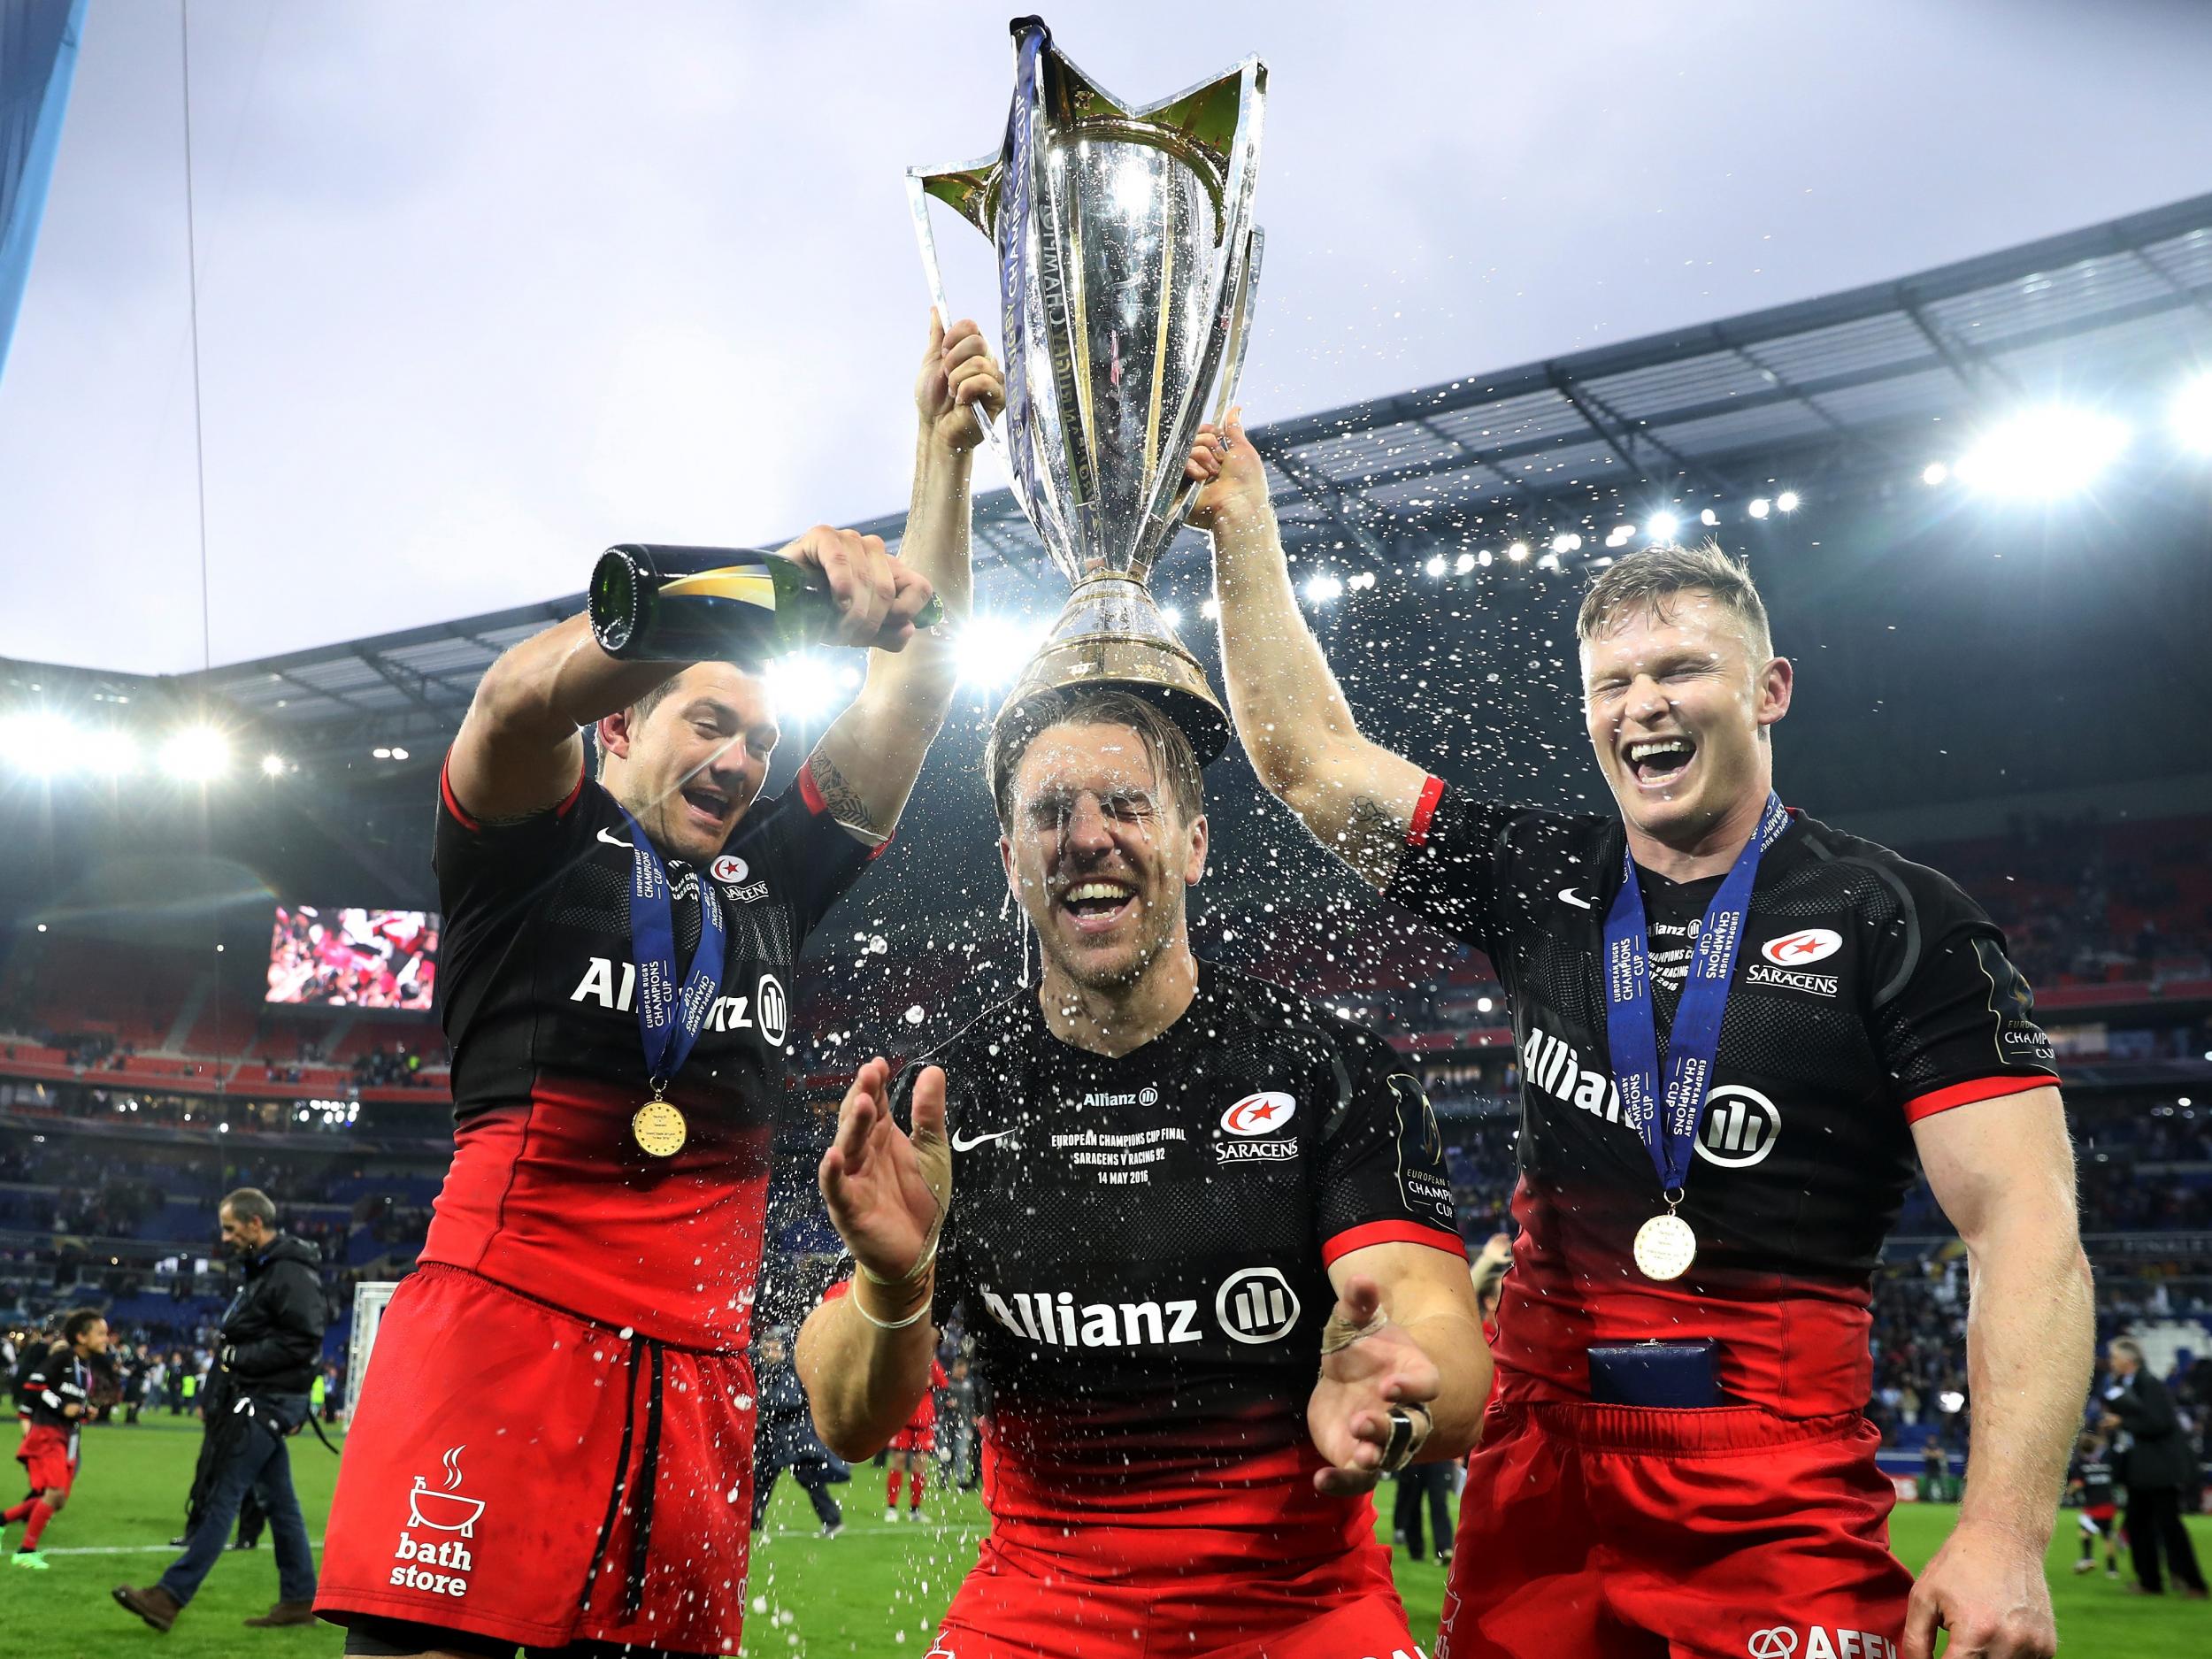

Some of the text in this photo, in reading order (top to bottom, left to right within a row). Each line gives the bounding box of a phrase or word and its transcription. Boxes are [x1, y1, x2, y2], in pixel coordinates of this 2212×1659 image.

[1016, 95, 1025, 144] CUP
[1008, 144, 1027, 298] CHAMPIONS
[1004, 303, 1018, 382] RUGBY
[641, 850, 654, 898] CHAMPIONS
[653, 867, 663, 885] CUP
[1647, 949, 1686, 964] HAMPIONS
[1700, 933, 1713, 956] CUP
[1706, 911, 1731, 979] CHAMPIONS
[1718, 911, 1740, 979] EUROPEAN RUGBY
[1620, 938, 1634, 1001] CHAMPIONS
[1633, 955, 1645, 977] CUP
[1662, 965, 1690, 979] RACING
[1747, 964, 1838, 994] SARACENS
[641, 963, 654, 1029] EUROPEAN RUGBY
[649, 961, 664, 1027] CHAMPIONS
[662, 980, 672, 1003] CUP
[683, 987, 695, 1009] CUP
[1612, 963, 1622, 1003] EUROPEAN
[1656, 977, 1679, 992] 2016
[685, 975, 710, 1033] CHAMPIONS
[689, 981, 716, 1038] EUROPEAN RUGBY
[1083, 1092, 1137, 1107] Allianz
[1643, 1095, 1654, 1120] CUP
[1665, 1081, 1679, 1108] CUP
[1673, 1057, 1697, 1136] CHAMPIONS
[1684, 1059, 1707, 1137] EUROPEAN RUGBY
[1051, 1127, 1187, 1148] EUROPEAN CHAMPIONS CUP FINAL
[1215, 1141, 1299, 1162] SARACENS
[1073, 1147, 1166, 1166] SARACENS V RACING 92
[1097, 1169, 1149, 1185] 14 MAY 2016
[1407, 1168, 1446, 1187] EUROPEAN
[979, 1284, 1203, 1348] Allianz
[395, 1532, 472, 1571] bath
[389, 1564, 467, 1597] store
